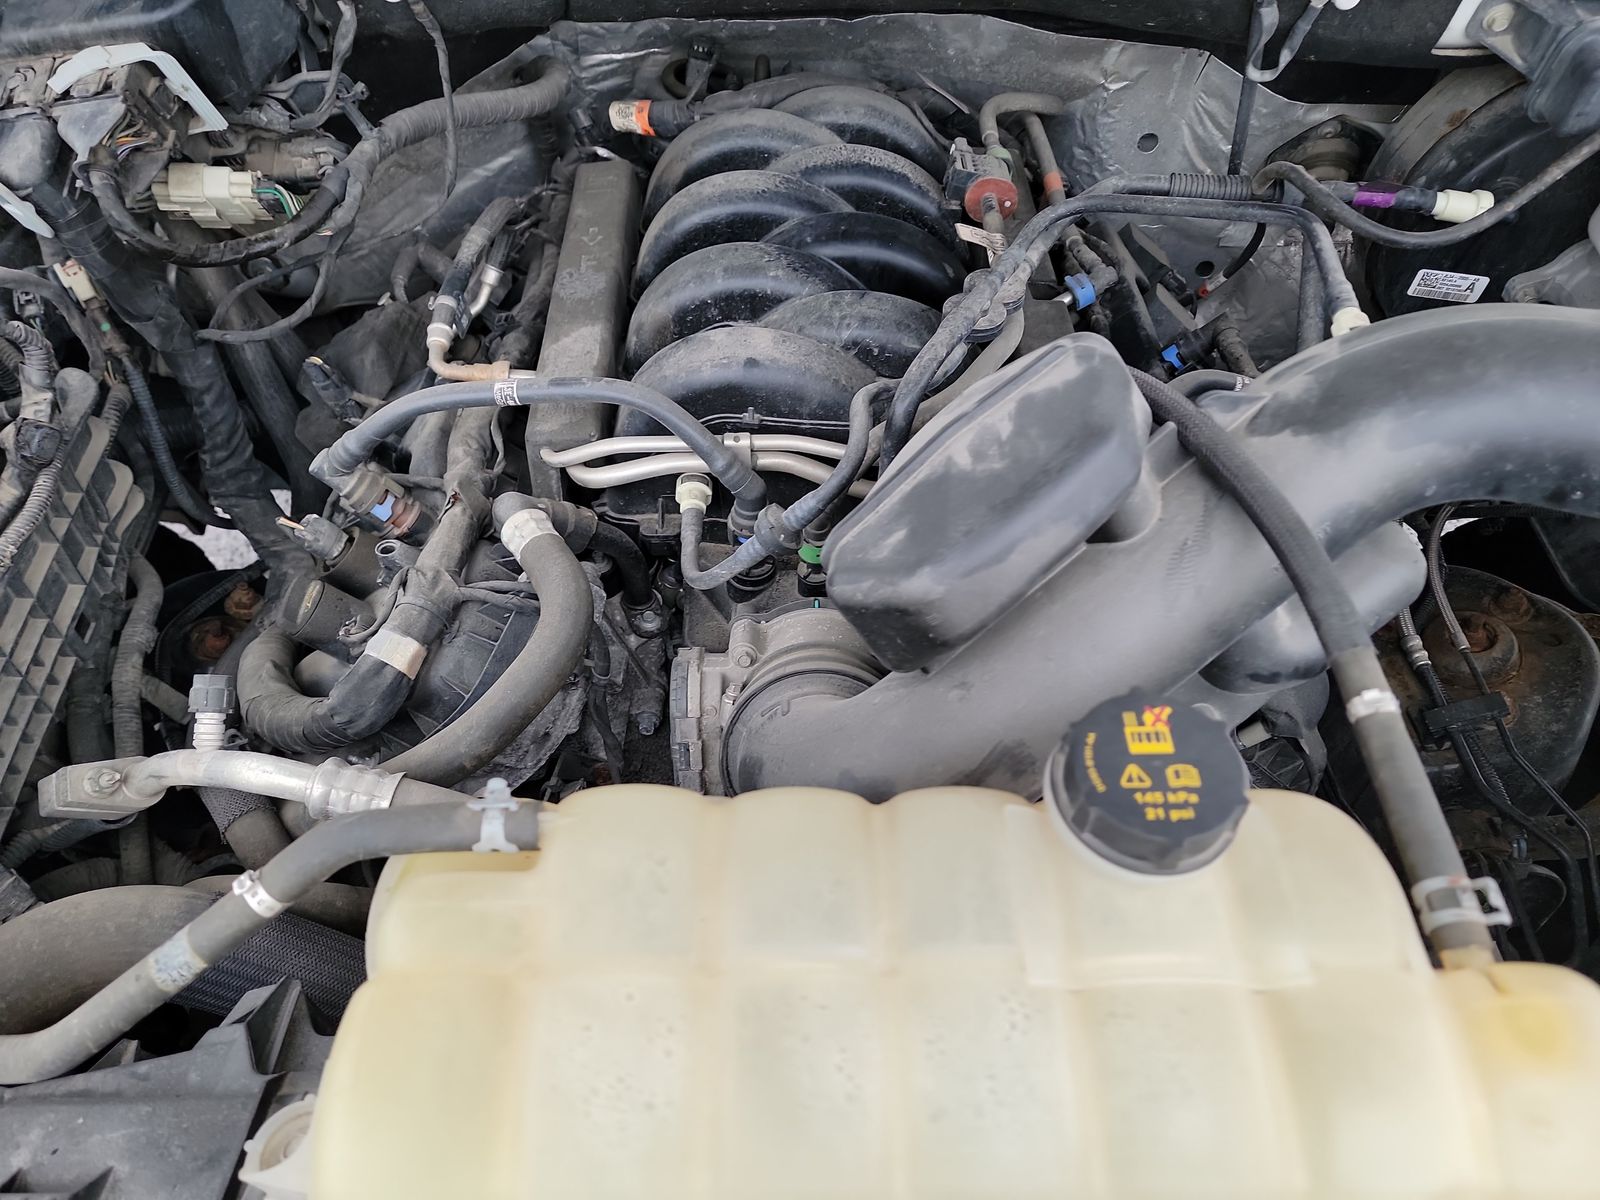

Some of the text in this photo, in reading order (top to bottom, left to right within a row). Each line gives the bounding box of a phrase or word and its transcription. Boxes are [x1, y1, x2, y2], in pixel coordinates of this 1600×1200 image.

[1464, 281, 1476, 294] A
[1133, 790, 1200, 805] 145 kPa
[1144, 806, 1196, 823] 21 psi
